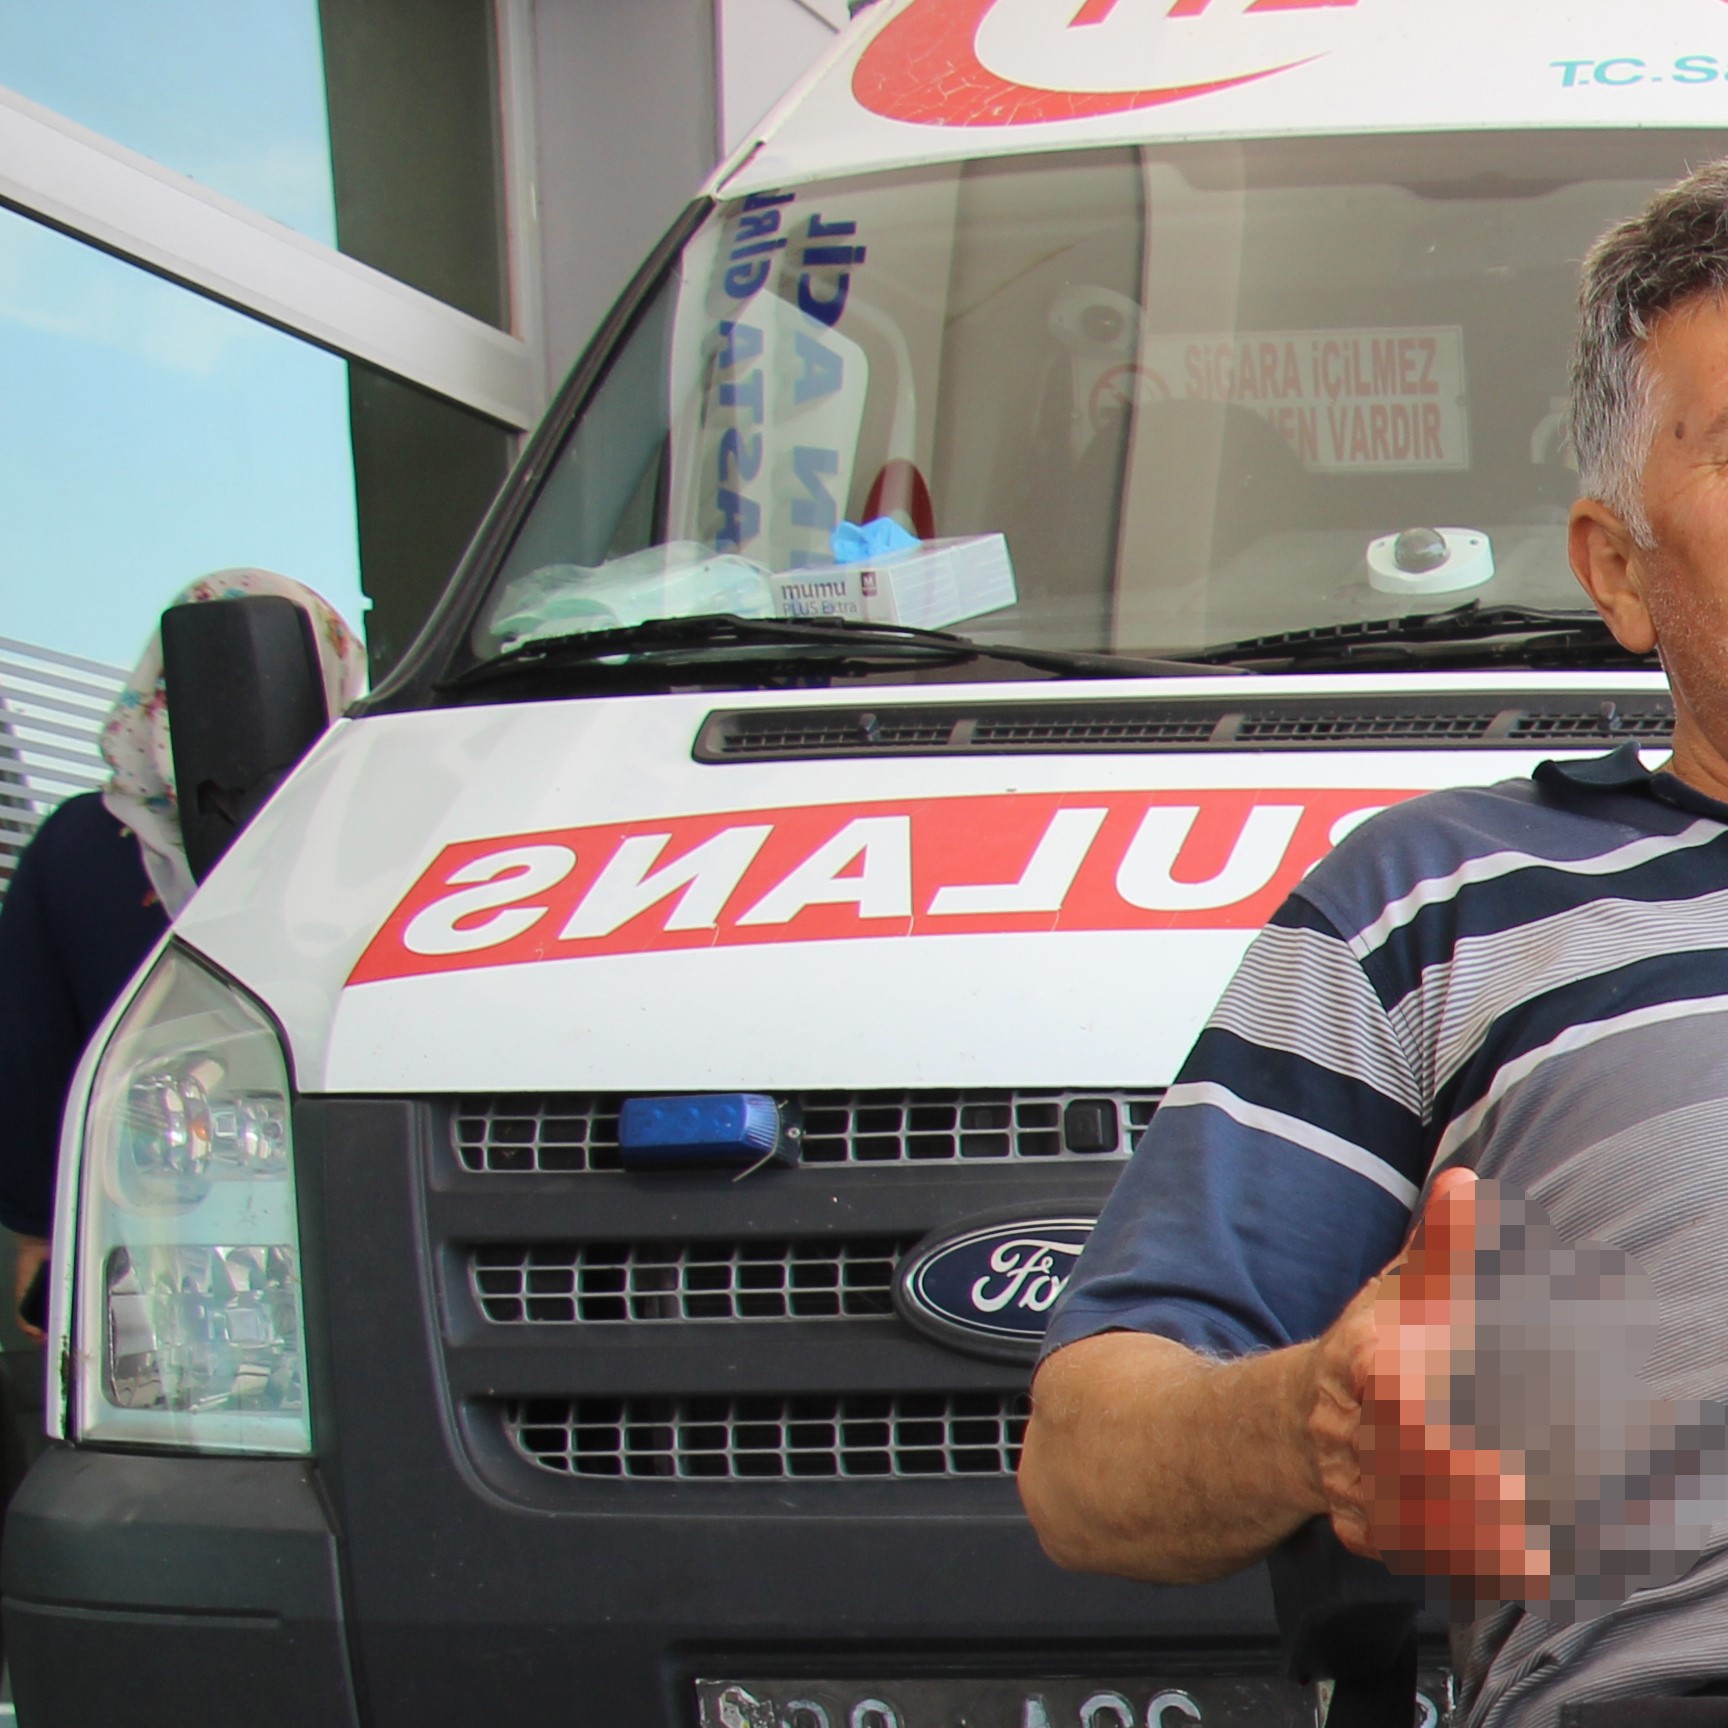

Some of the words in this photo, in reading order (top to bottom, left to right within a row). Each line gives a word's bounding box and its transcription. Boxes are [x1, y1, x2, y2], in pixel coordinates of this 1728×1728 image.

[1326, 402, 1445, 462] VARDIR
[781, 580, 847, 600] mumu
[821, 600, 858, 616] Extra
[971, 1238, 1085, 1313] Fo
